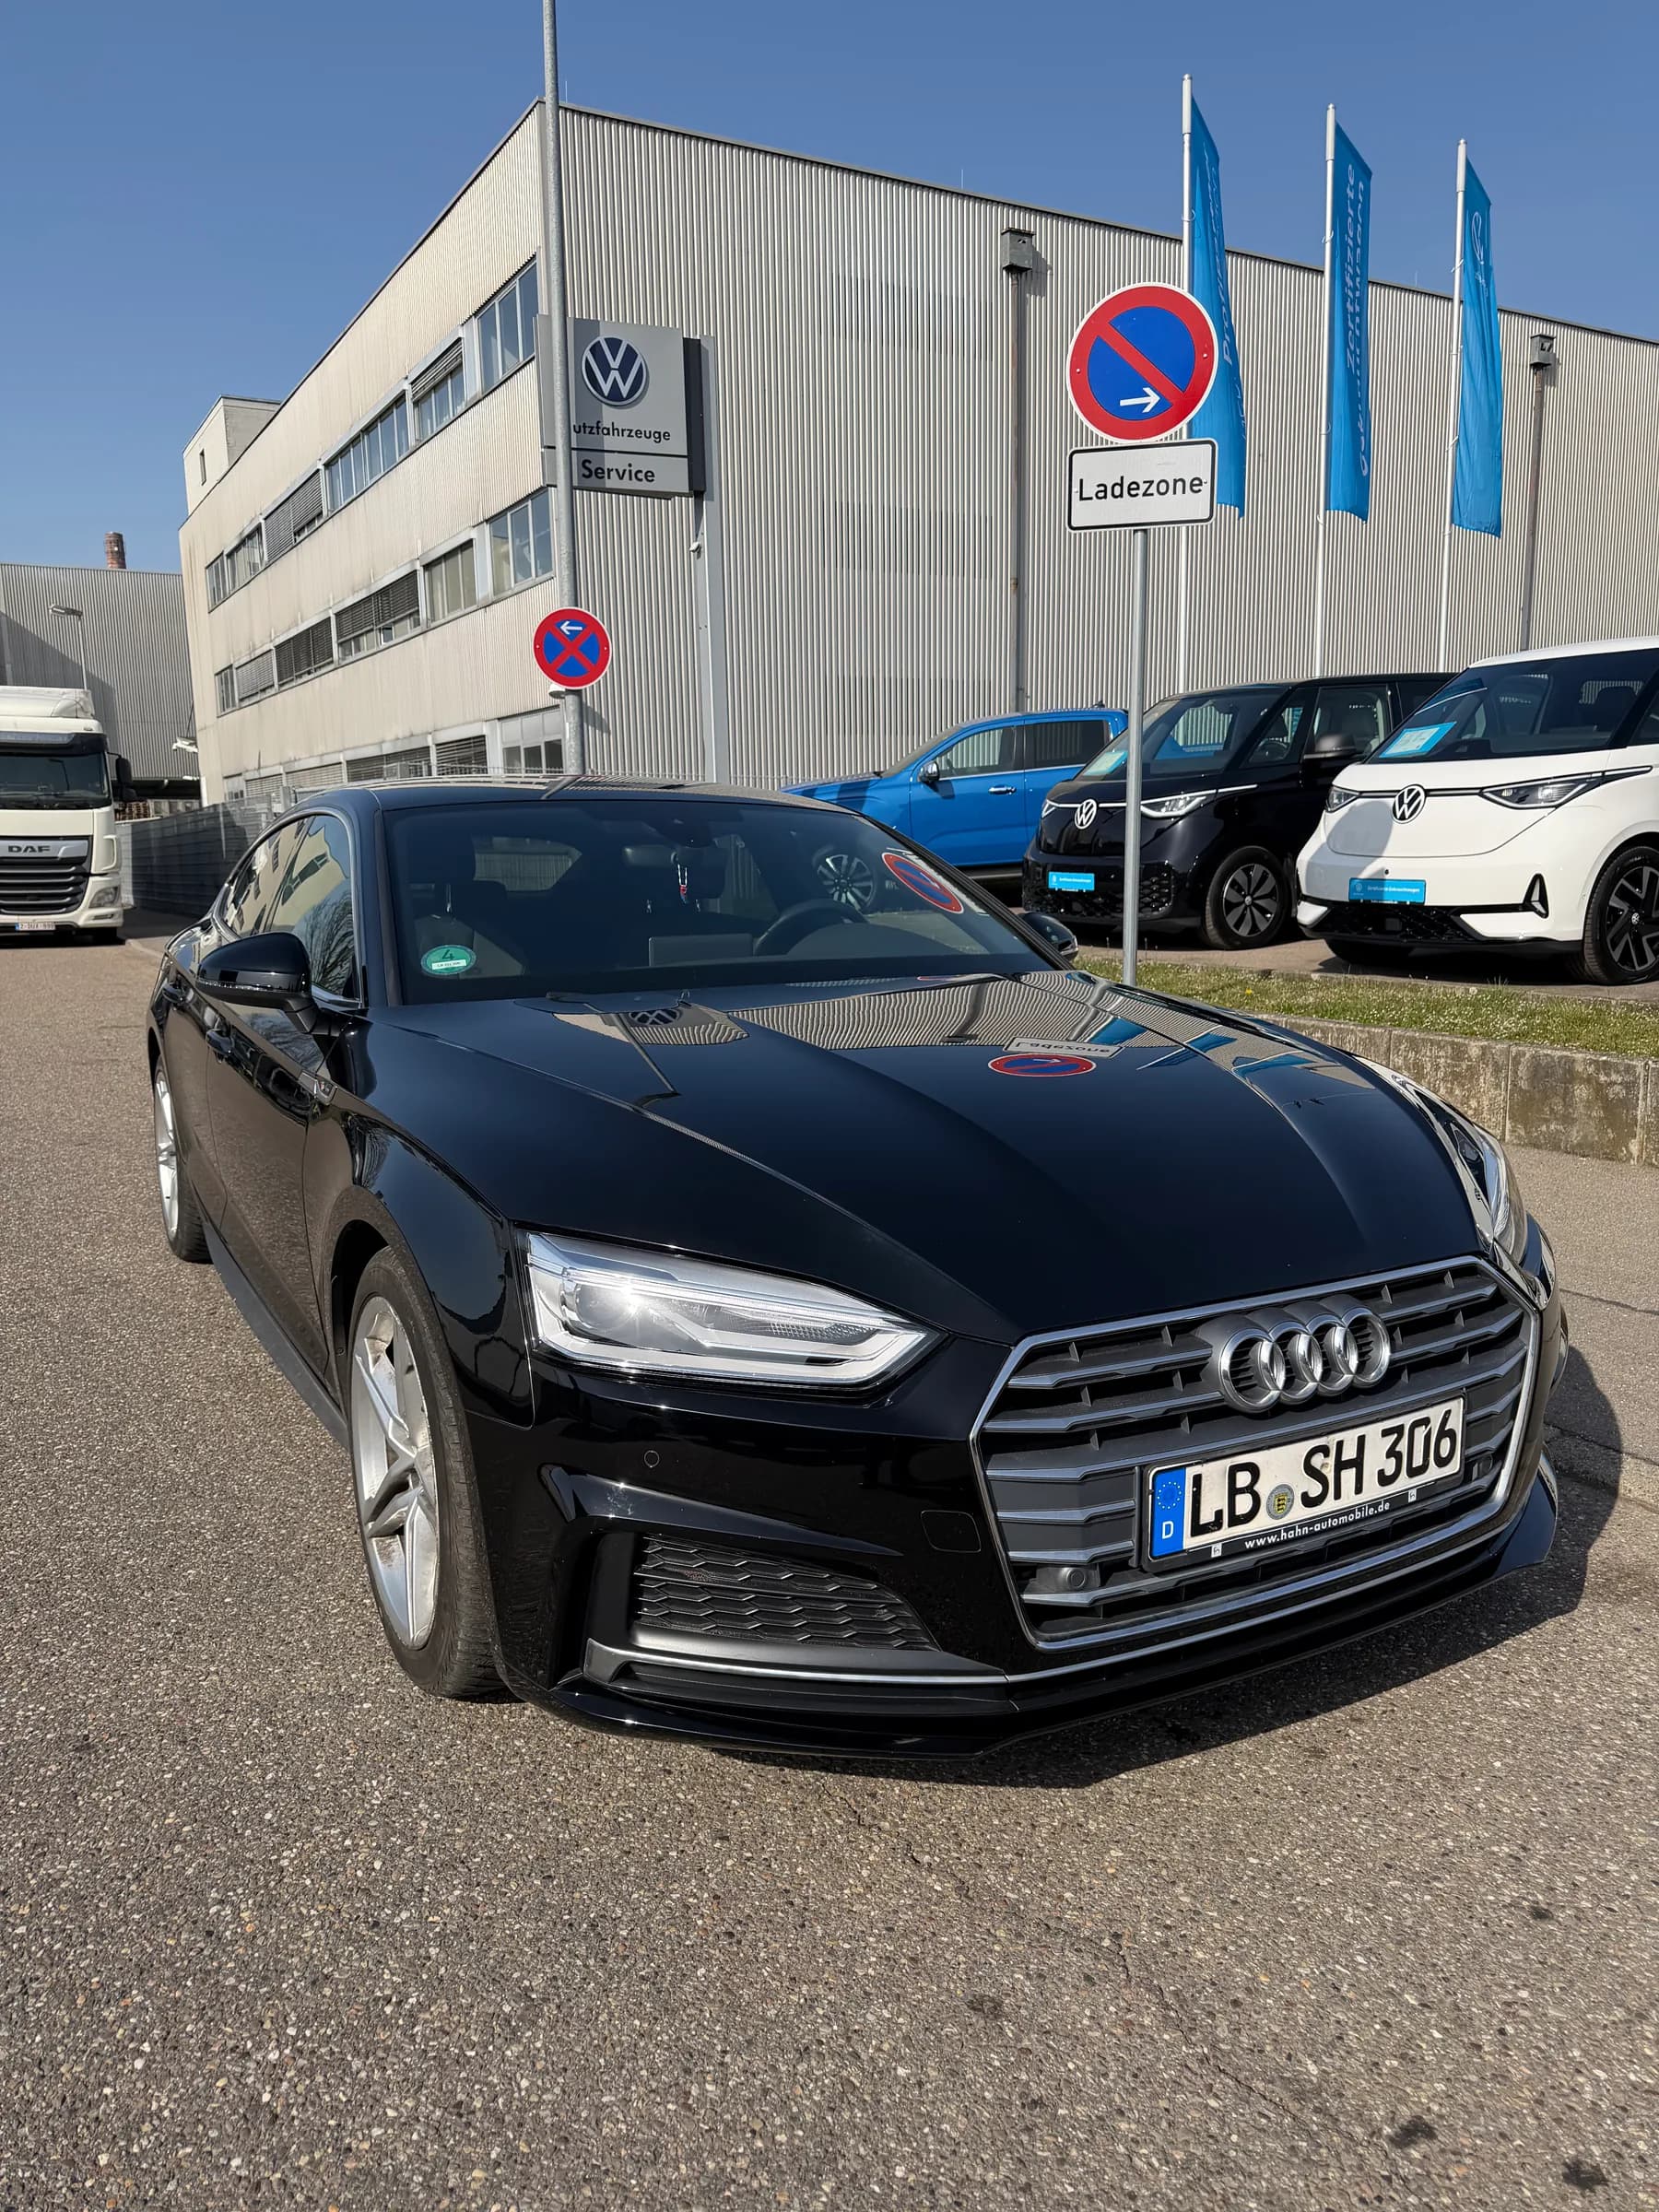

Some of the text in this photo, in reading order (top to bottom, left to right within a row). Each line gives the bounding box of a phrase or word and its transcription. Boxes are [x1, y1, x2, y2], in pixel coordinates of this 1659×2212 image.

[572, 420, 671, 443] utzfahrzeuge
[581, 459, 656, 483] Service
[1078, 476, 1204, 502] Ladezone
[7, 844, 51, 853] DAF
[442, 948, 454, 960] 4
[1189, 1408, 1457, 1538] LB SH 306
[1161, 1521, 1174, 1540] D
[1244, 1500, 1391, 1549] www.hahn-automobile.de
